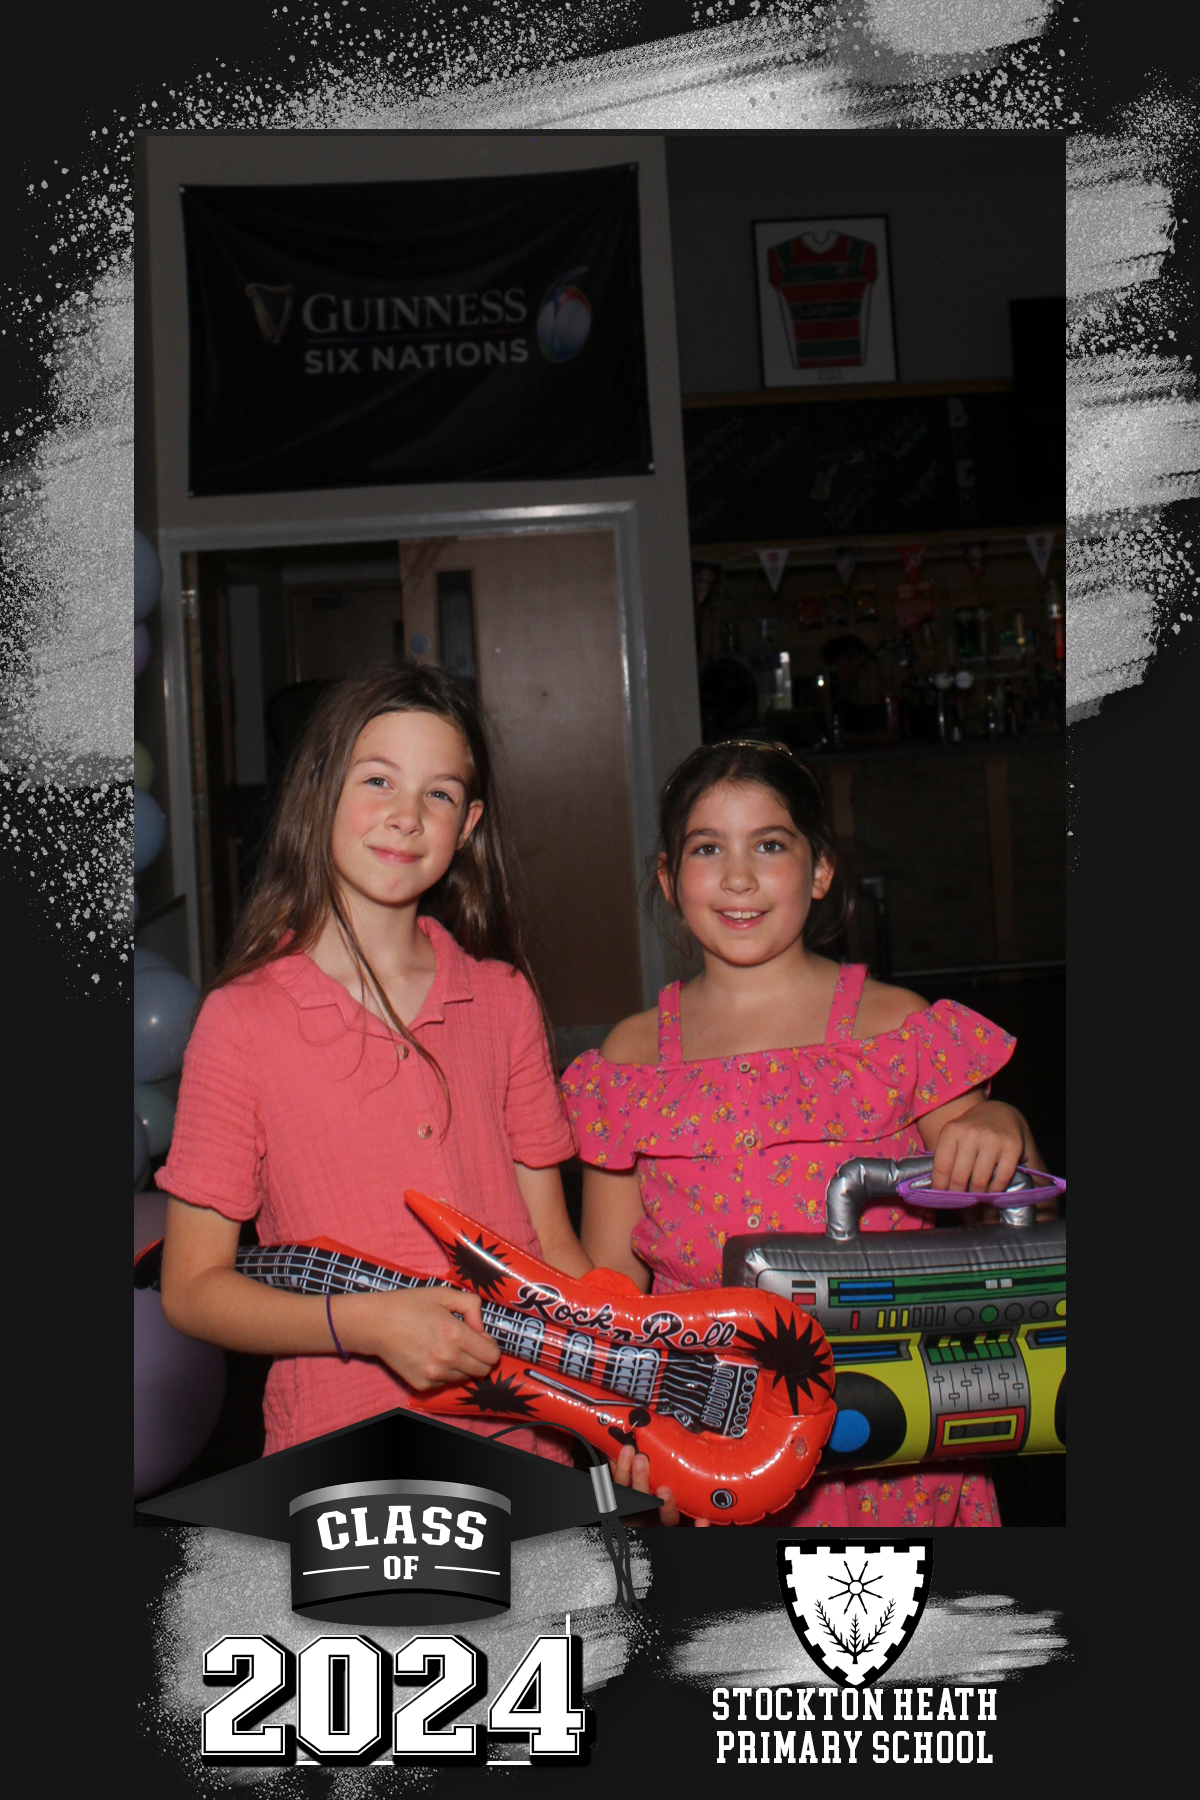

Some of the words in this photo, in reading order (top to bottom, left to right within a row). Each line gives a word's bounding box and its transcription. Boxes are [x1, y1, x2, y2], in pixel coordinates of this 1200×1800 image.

[301, 287, 528, 334] GUINNESS
[304, 346, 361, 376] SIX
[371, 338, 529, 372] NATIONS
